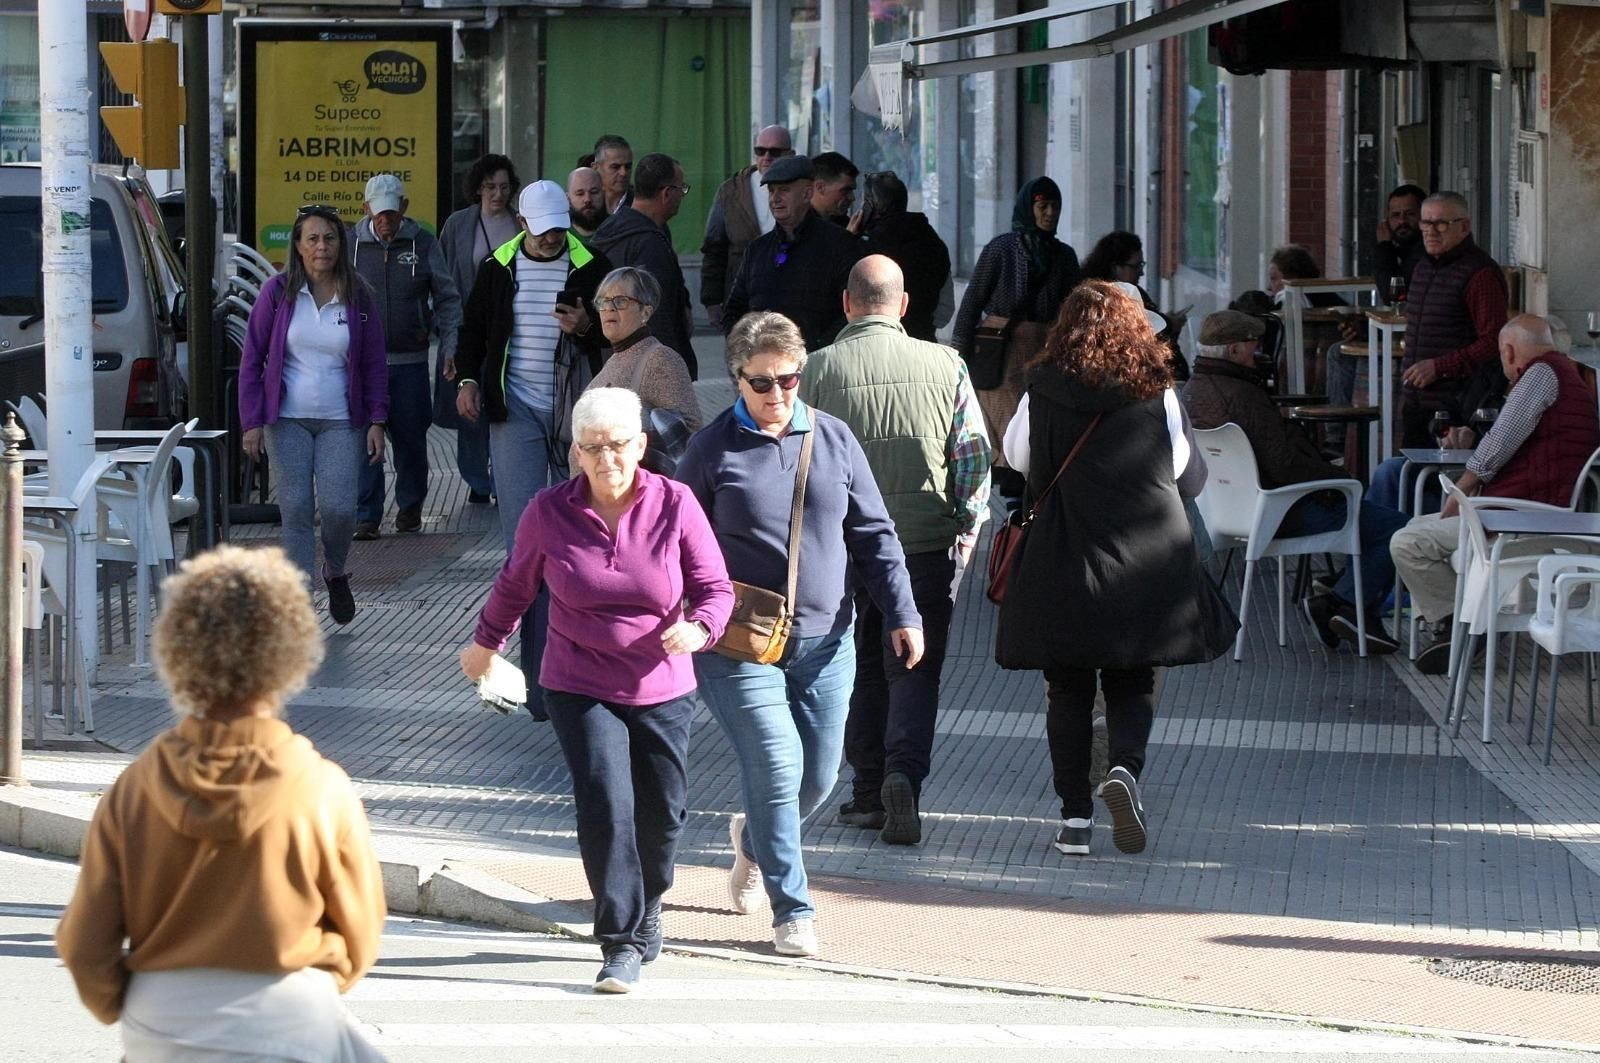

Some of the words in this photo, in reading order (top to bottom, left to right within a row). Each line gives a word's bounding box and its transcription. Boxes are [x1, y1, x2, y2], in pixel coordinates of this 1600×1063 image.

[371, 61, 418, 83] HOLA!
[314, 104, 381, 123] Supeco
[279, 137, 416, 157] ¡ABRIMOS!
[284, 171, 300, 182] 14
[306, 171, 326, 182] DE
[303, 191, 330, 201] Calle
[334, 191, 352, 201] Río
